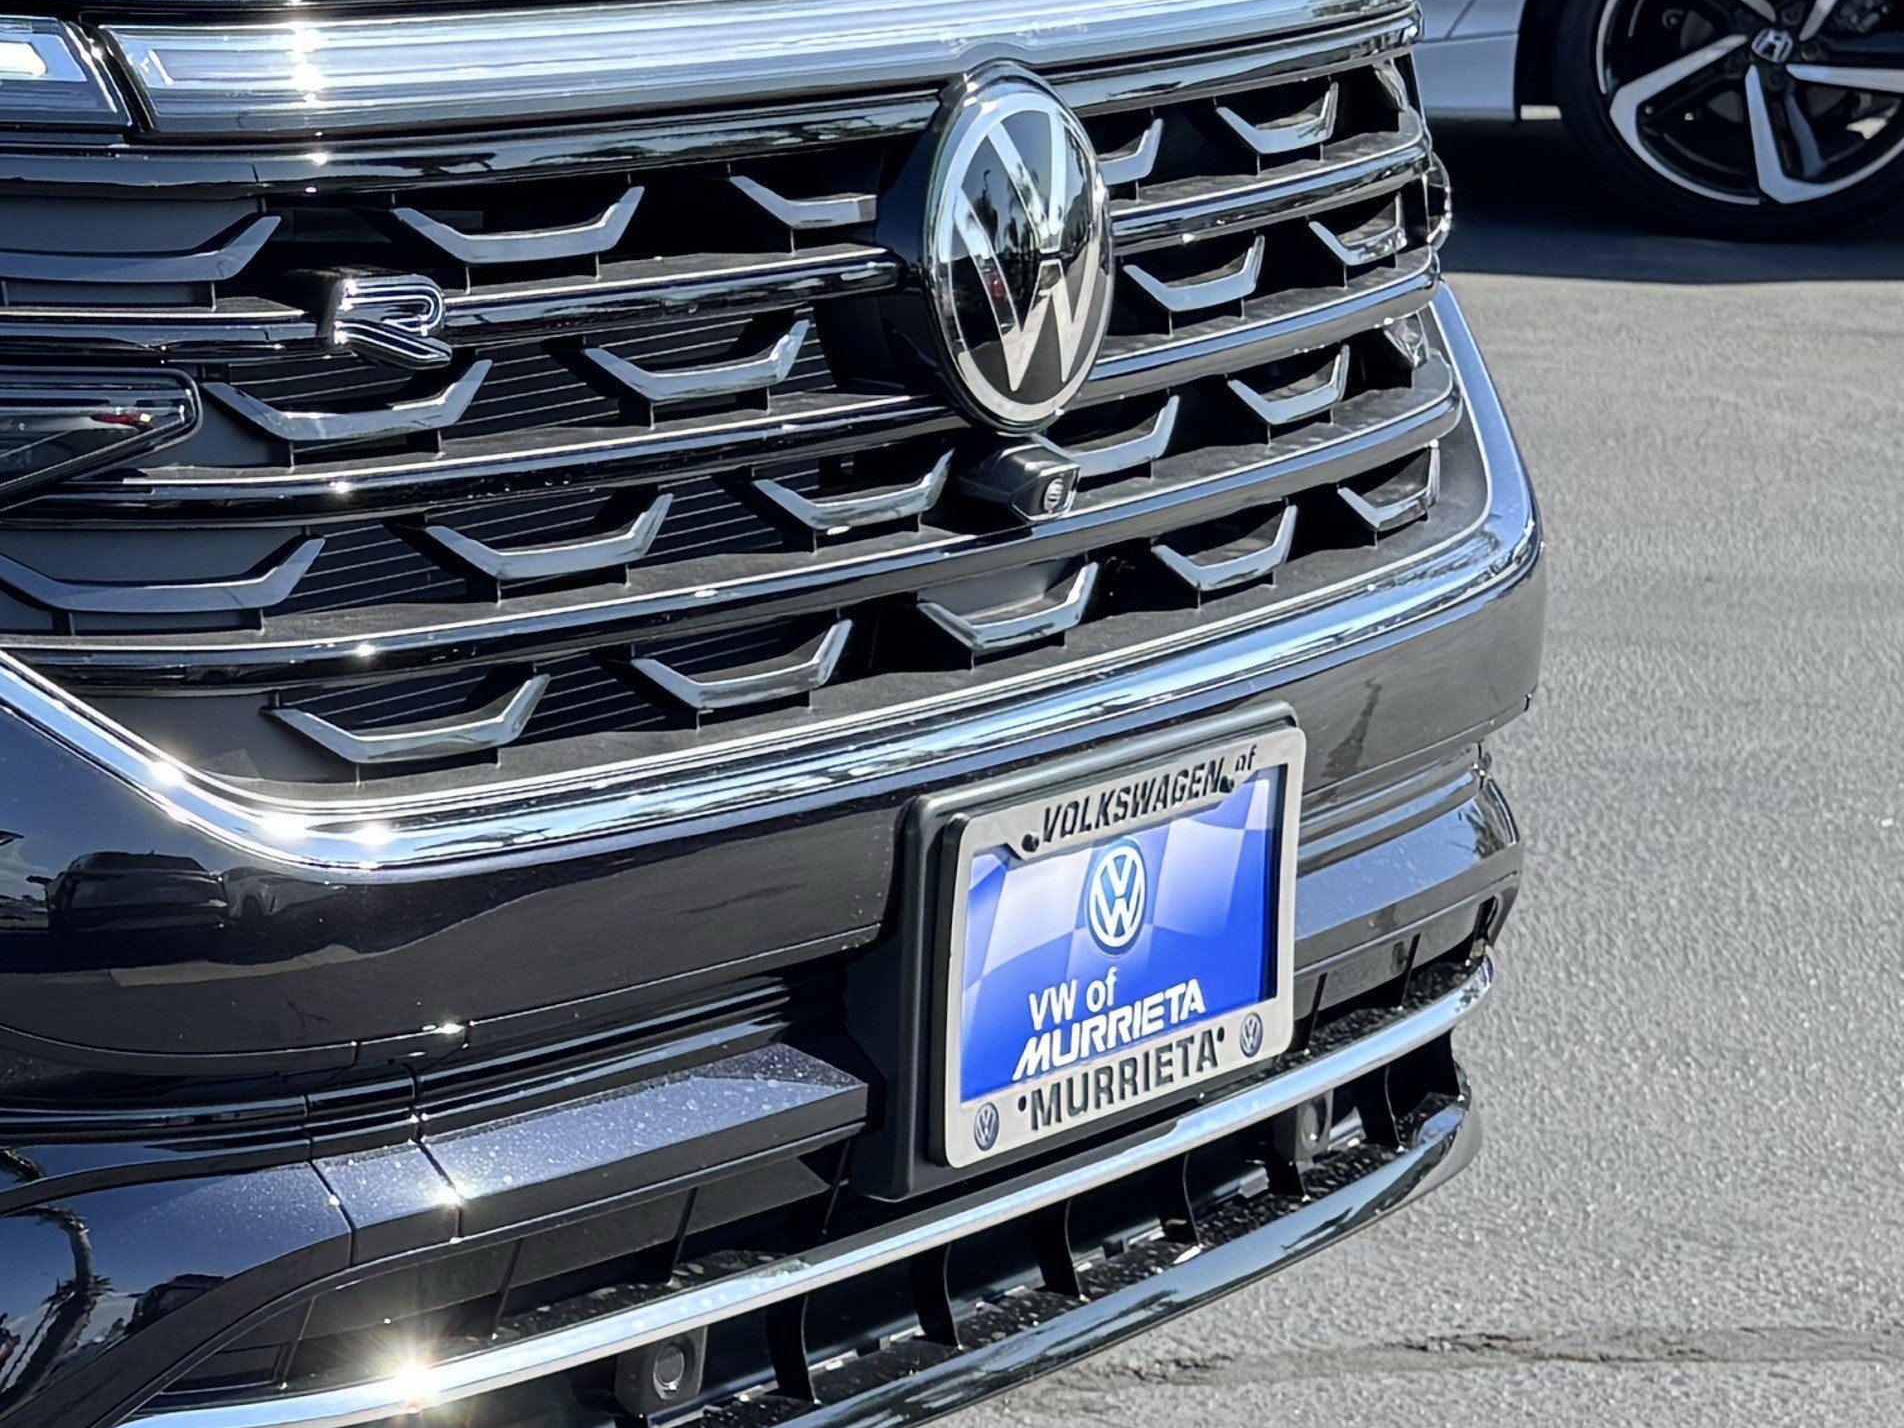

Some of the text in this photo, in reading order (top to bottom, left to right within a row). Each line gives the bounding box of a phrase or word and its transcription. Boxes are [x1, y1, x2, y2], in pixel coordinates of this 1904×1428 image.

[932, 80, 1113, 428] VW
[1042, 744, 1257, 844] VOLKSWAGEN of
[1086, 838, 1148, 952] VW
[1011, 978, 1207, 1082] MURRIETA
[1028, 965, 1118, 1031] VW of
